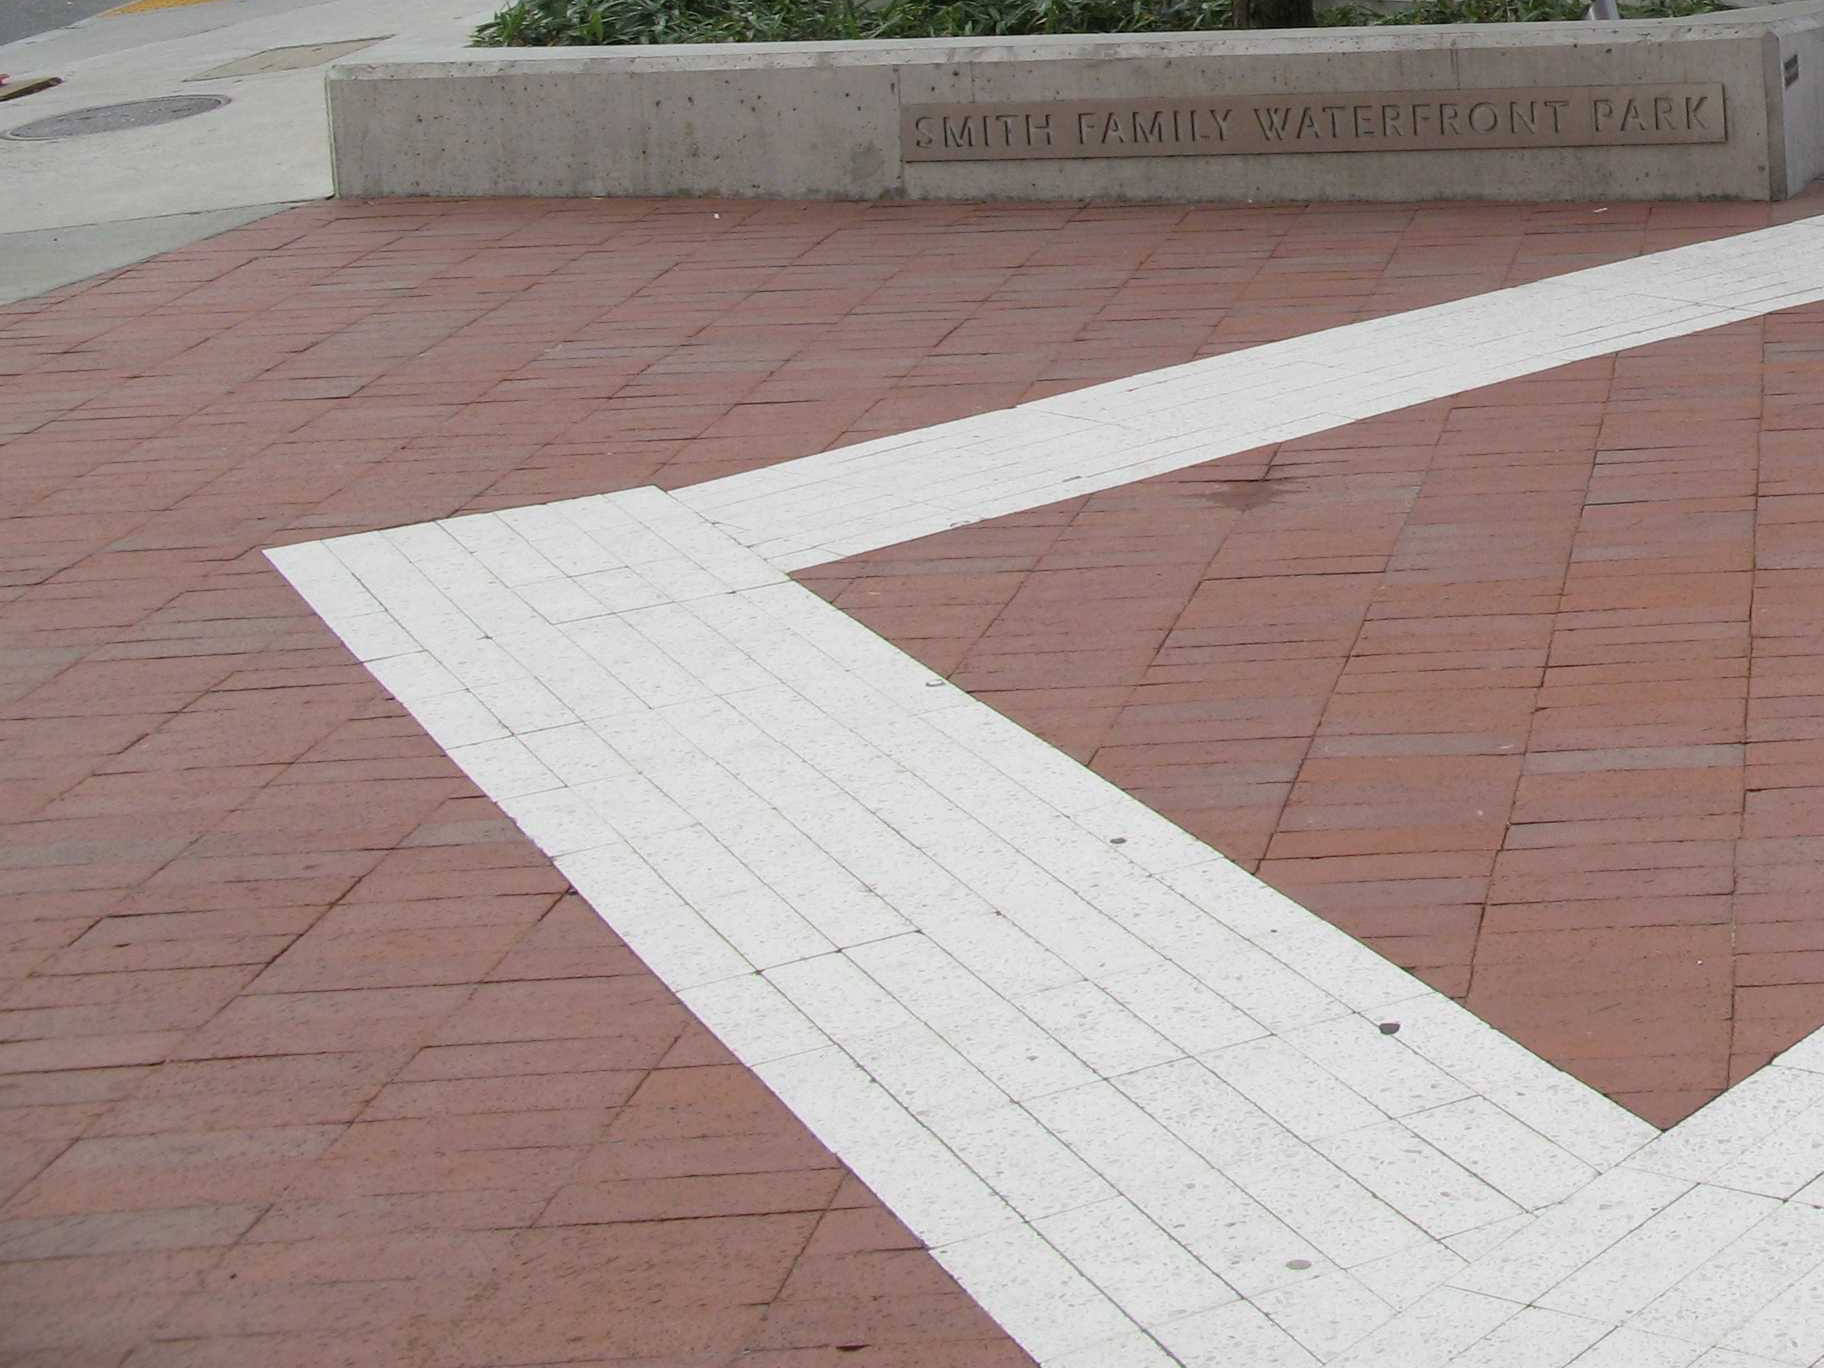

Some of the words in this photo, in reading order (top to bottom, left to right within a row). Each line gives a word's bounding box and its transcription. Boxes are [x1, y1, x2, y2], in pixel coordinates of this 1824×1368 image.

[915, 113, 1052, 149] SMITH
[1078, 108, 1233, 146] FAMILY
[1254, 98, 1569, 142] WATERFRONT
[1593, 95, 1710, 133] PARK
